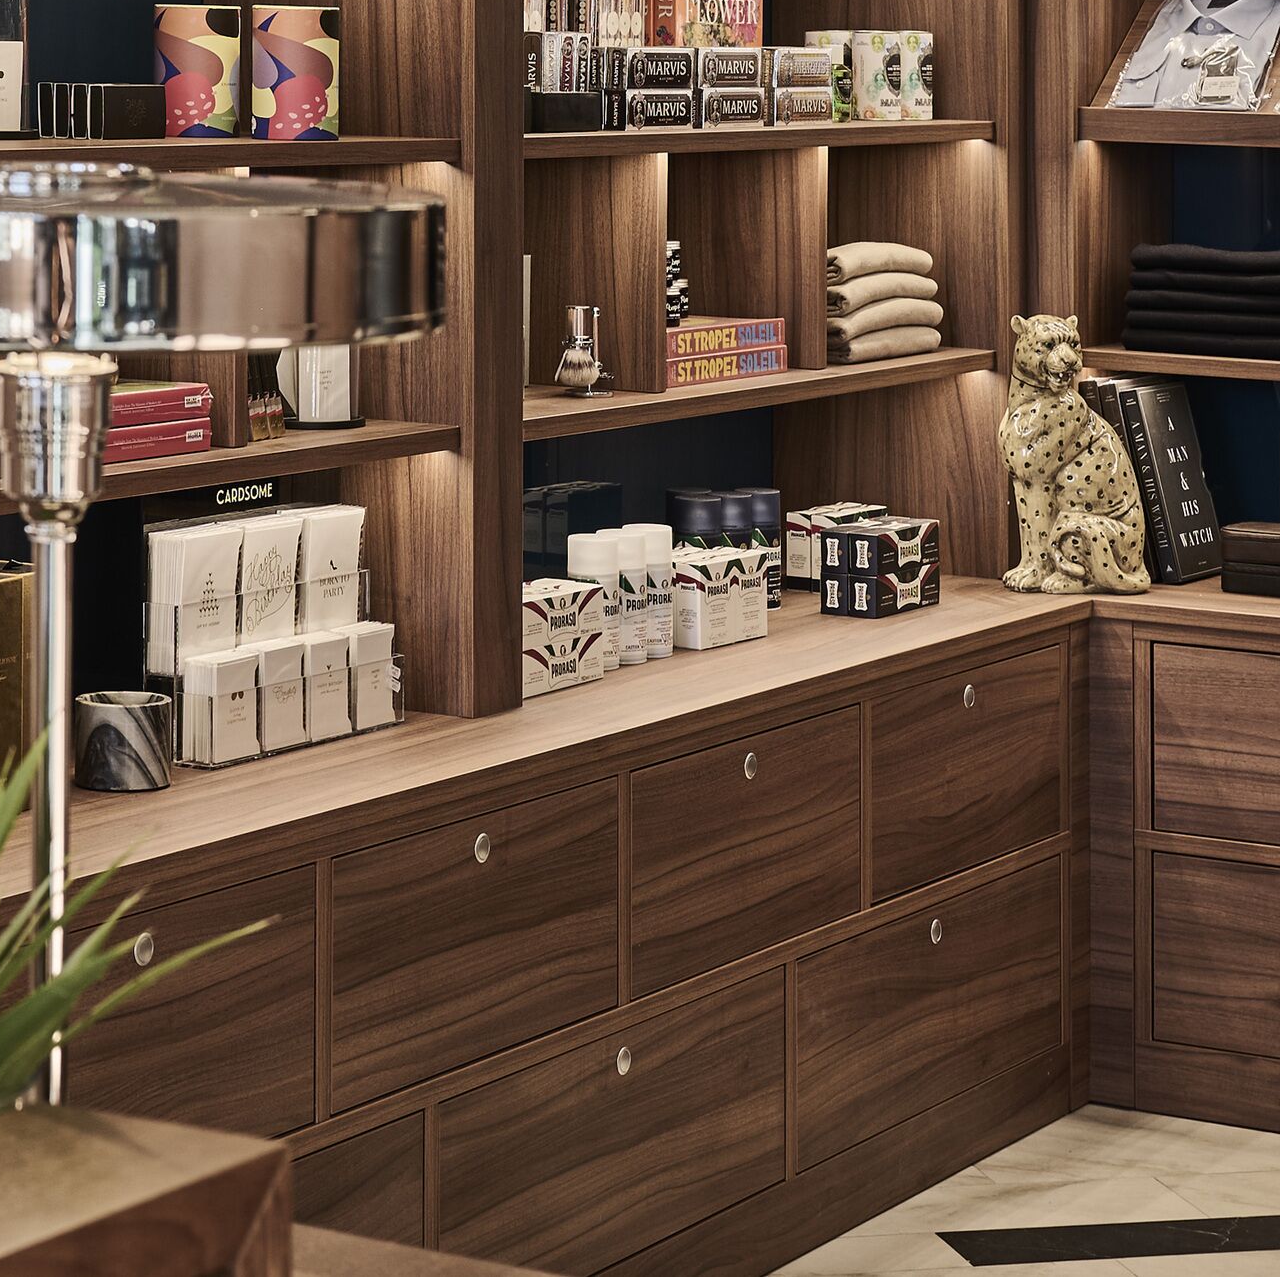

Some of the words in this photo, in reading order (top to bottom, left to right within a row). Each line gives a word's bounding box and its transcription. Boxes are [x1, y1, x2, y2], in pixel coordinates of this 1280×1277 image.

[527, 52, 537, 87] ARVIS
[647, 61, 687, 76] MARVIS
[718, 60, 756, 74] MARVIS
[646, 102, 687, 117] MARVIS
[722, 99, 758, 114] MARVIS
[793, 99, 827, 114] MARVIS
[738, 322, 777, 347] SOLEIL
[740, 350, 779, 374] SOLEIL
[1130, 421, 1140, 429] A
[1167, 415, 1175, 432] A
[1133, 434, 1148, 461] MAN
[1166, 445, 1189, 465] MAN
[1141, 465, 1150, 474] &
[1145, 478, 1157, 501] HIS
[1180, 471, 1190, 491] &
[216, 482, 273, 505] CARDSOME
[1181, 499, 1200, 518] HIS
[1151, 504, 1169, 549] WATCH
[1179, 527, 1214, 549] WATCH
[900, 543, 919, 560] PRORASO
[245, 544, 282, 591] Happy
[323, 586, 345, 598] PARTY
[708, 583, 728, 598] PRORASO
[741, 576, 761, 591] PRORASO
[246, 563, 293, 637] Birthday
[899, 585, 919, 604] PRORASO
[550, 611, 577, 631] PRORASO
[551, 658, 577, 679] PRORASO
